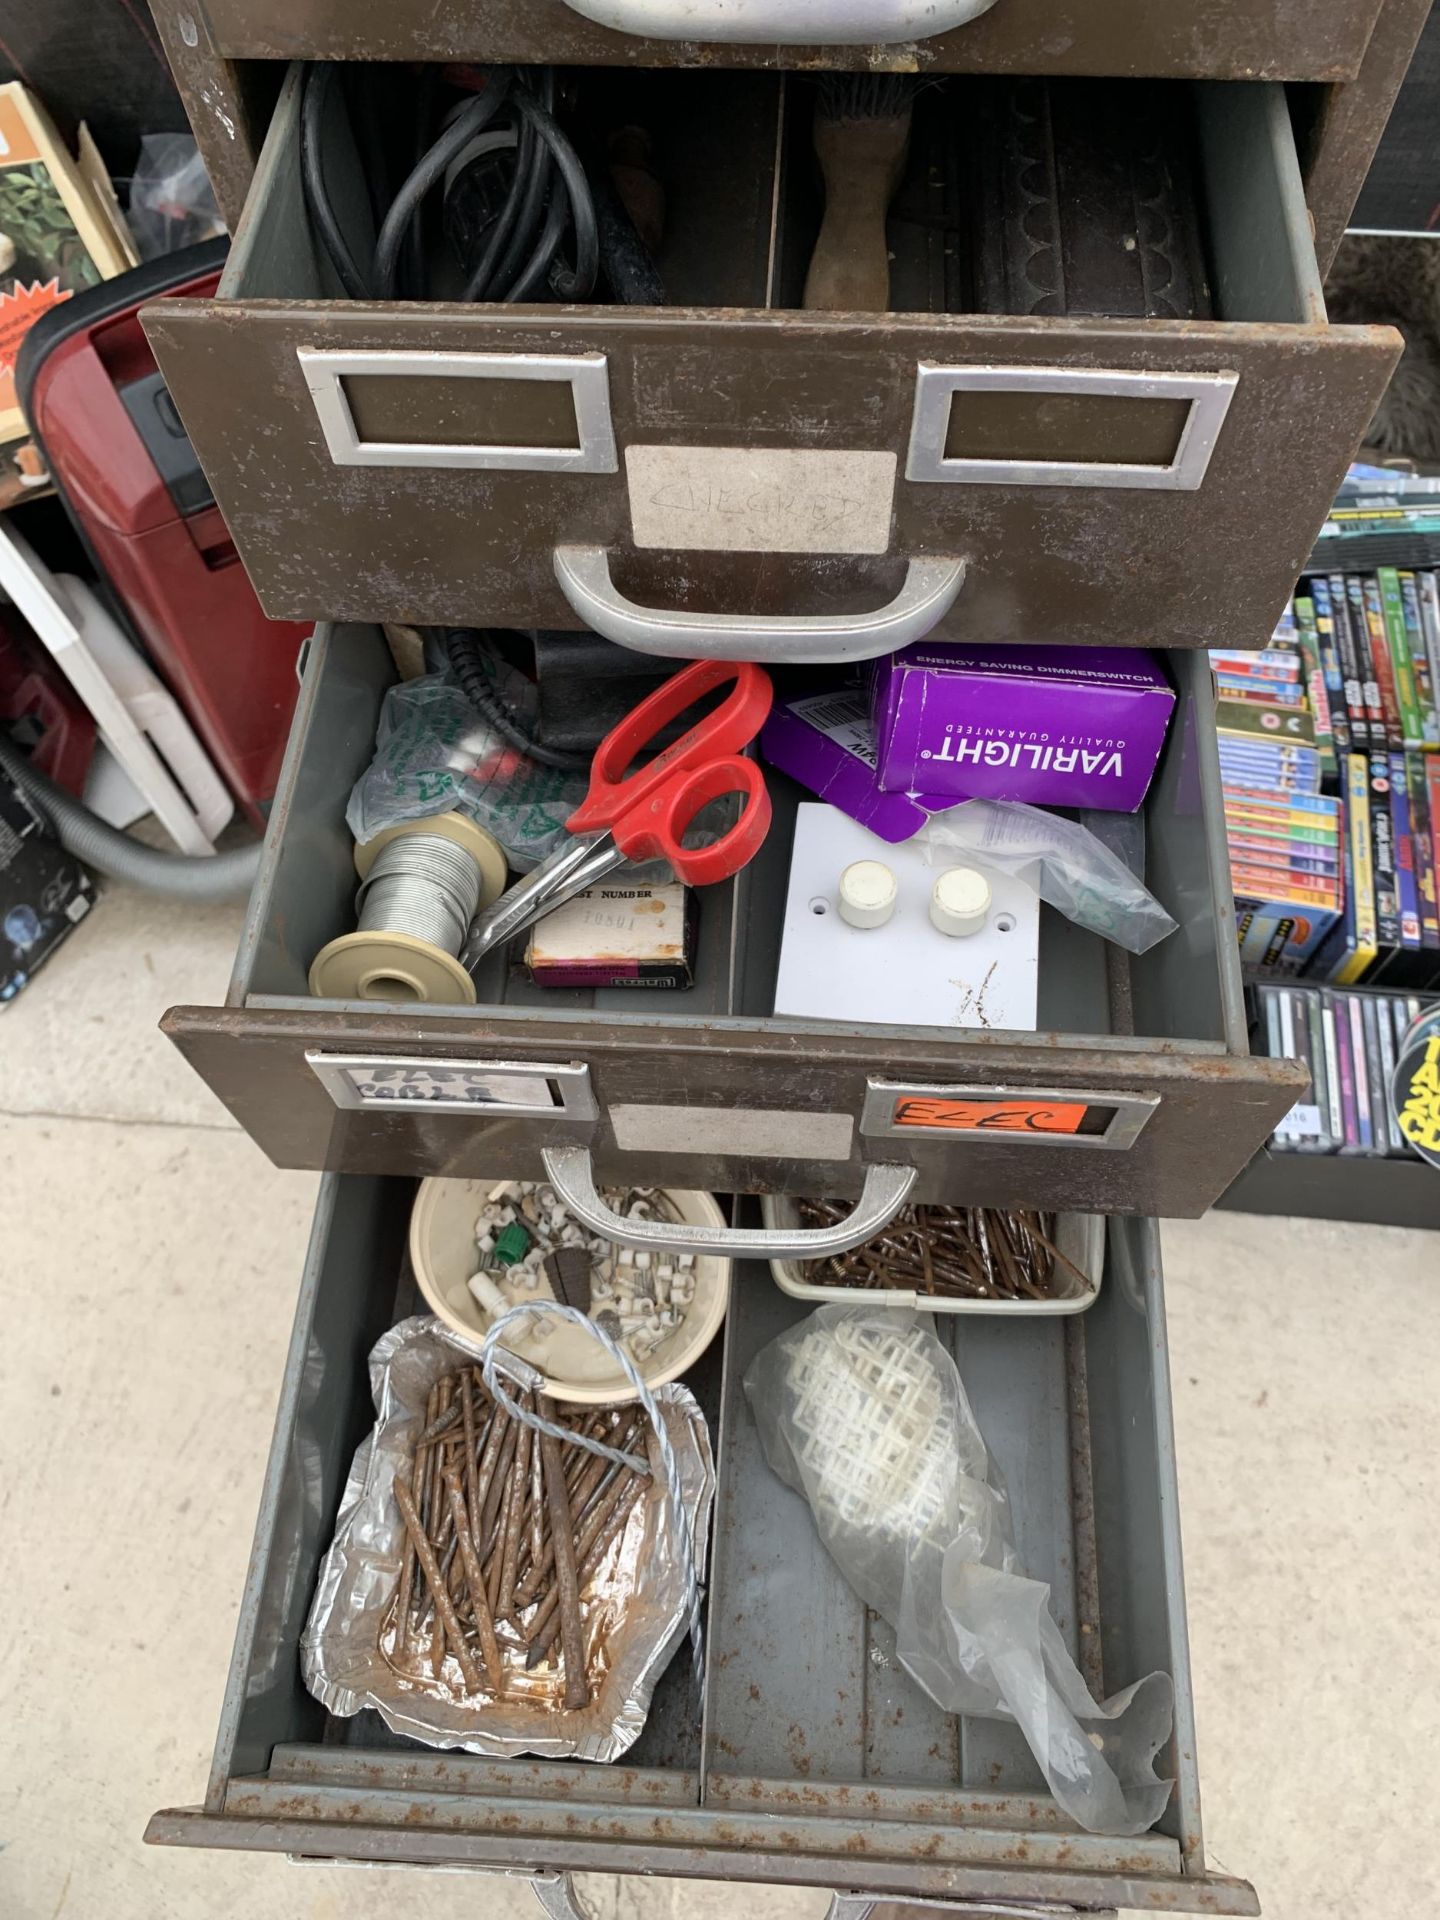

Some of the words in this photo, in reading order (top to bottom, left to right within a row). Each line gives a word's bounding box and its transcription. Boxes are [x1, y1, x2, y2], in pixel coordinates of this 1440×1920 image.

[915, 655, 977, 669] ENERGY
[979, 661, 1034, 672] SAVING
[1036, 666, 1155, 683] DIMMERSWITCH
[944, 724, 1049, 742] GUARANTEED
[1059, 735, 1126, 749] QUALITY
[601, 890, 652, 899] NUMBER
[895, 1101, 1056, 1131] ELEC
